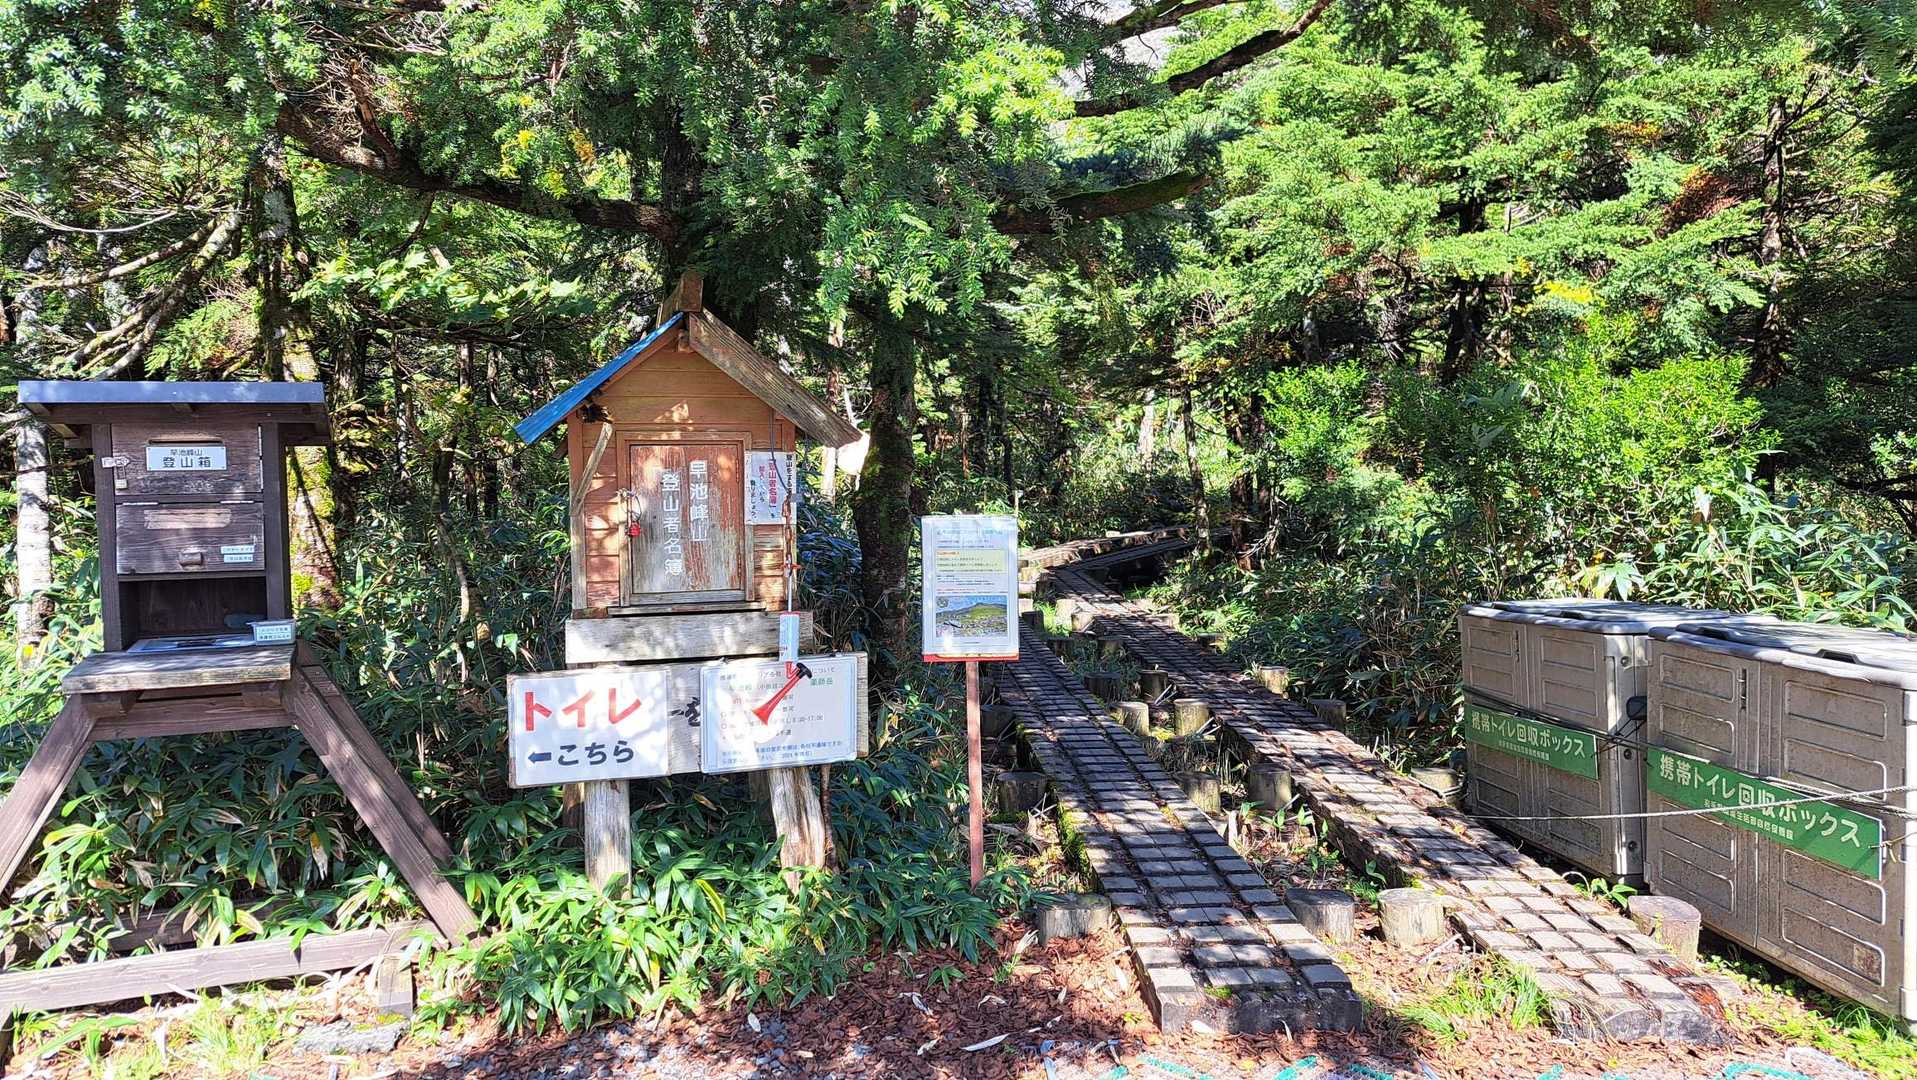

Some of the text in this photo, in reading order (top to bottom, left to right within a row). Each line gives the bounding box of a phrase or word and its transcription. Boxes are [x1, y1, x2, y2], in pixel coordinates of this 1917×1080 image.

[162, 456, 212, 468] 登山箱
[661, 473, 683, 576] 登山者名簿
[524, 687, 642, 732] トイレ
[557, 740, 635, 766] こちら
[1472, 710, 1586, 758] 携帯トイレ回収ボックス
[1660, 753, 1861, 848] 携帯トイレ回収ボックス
